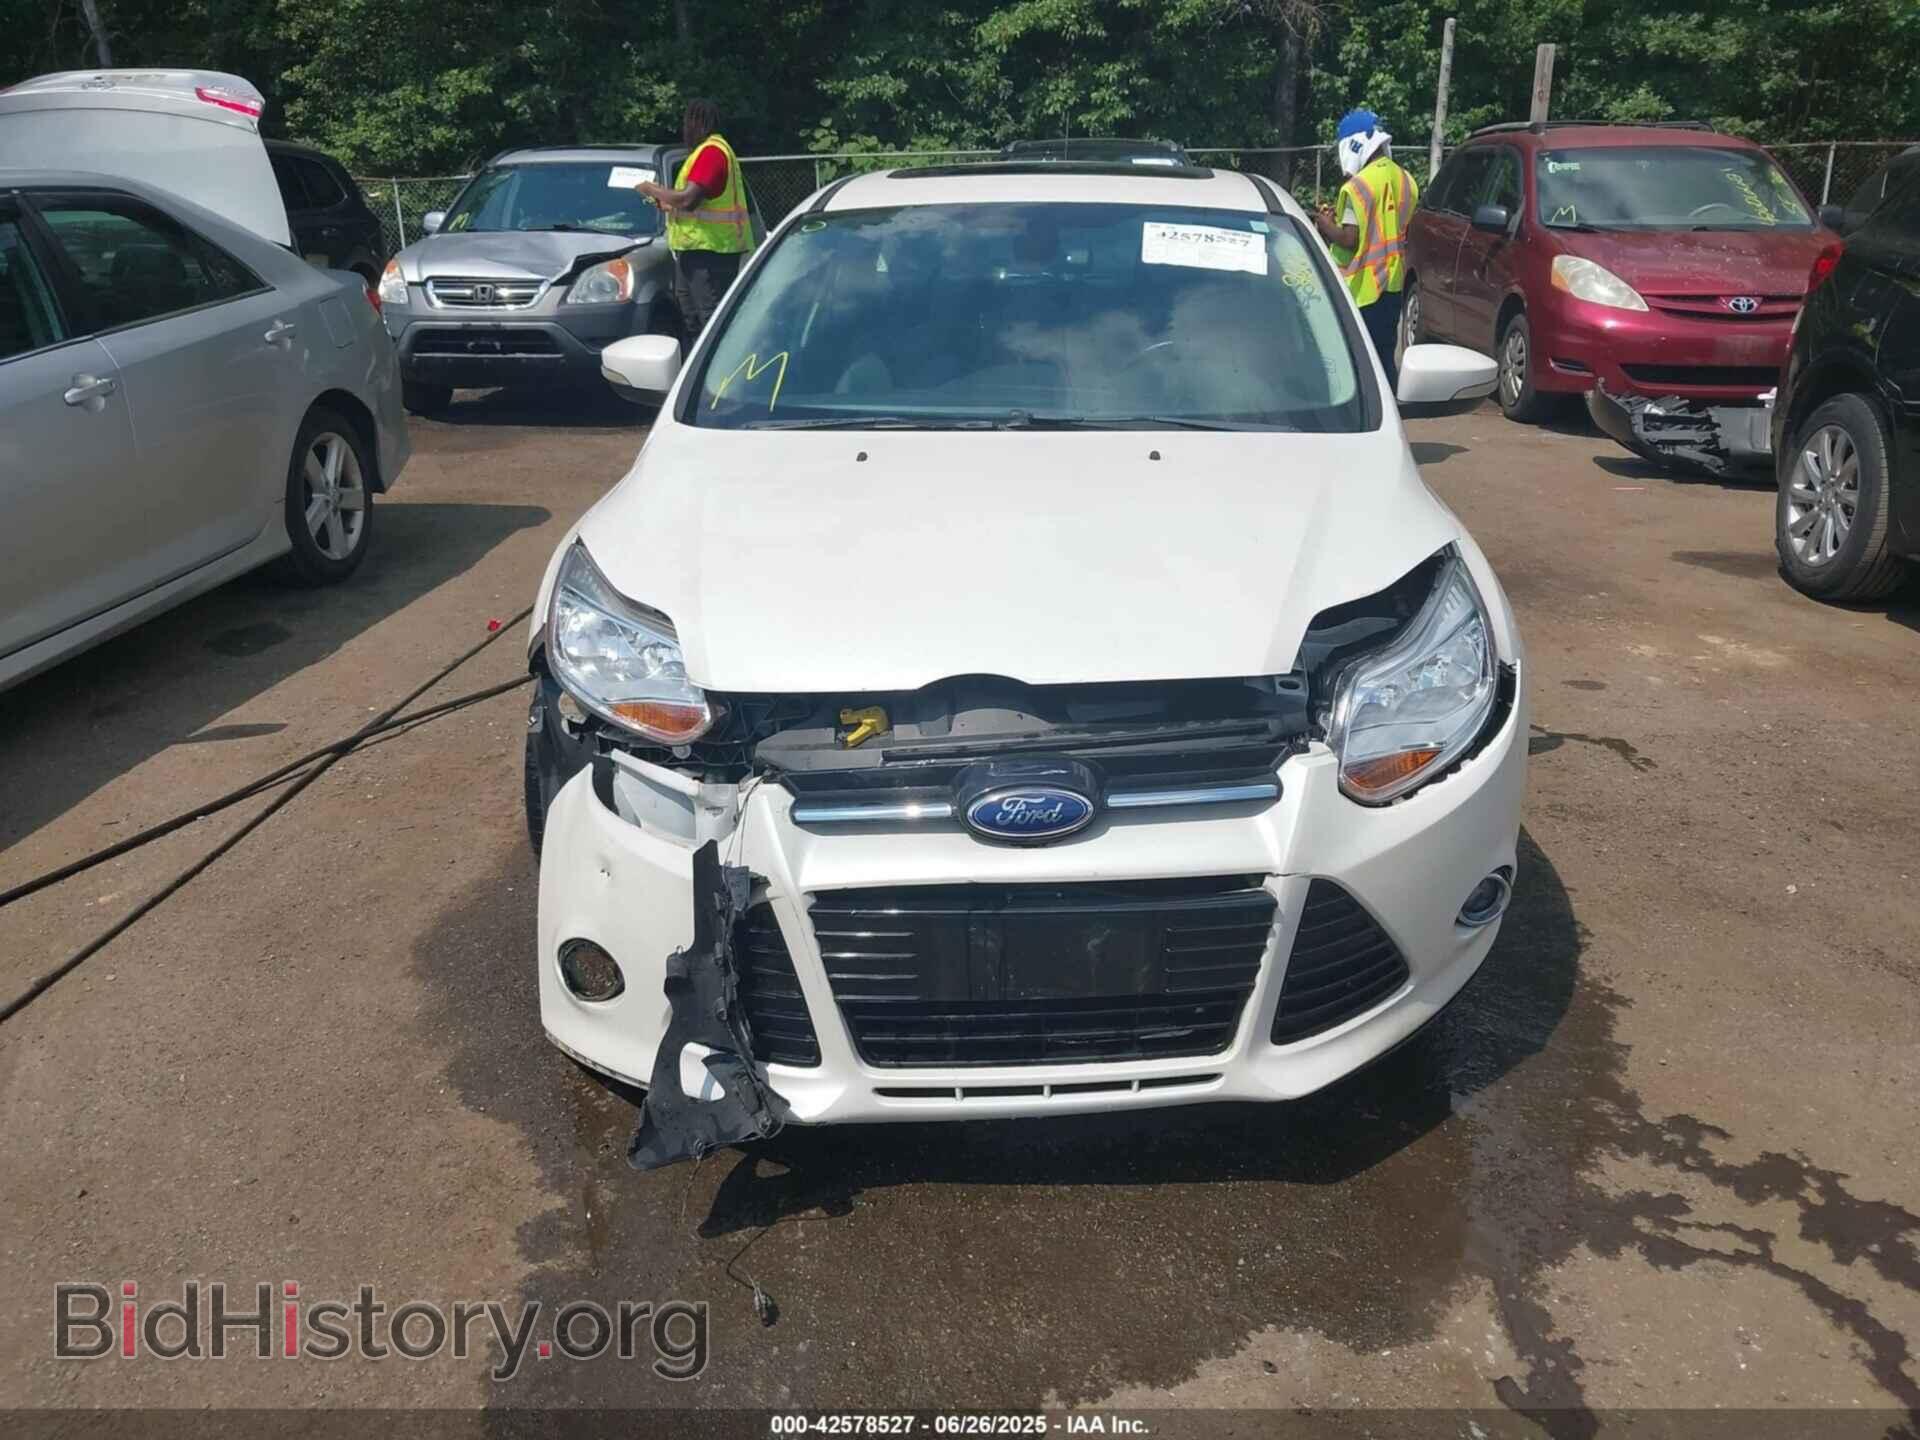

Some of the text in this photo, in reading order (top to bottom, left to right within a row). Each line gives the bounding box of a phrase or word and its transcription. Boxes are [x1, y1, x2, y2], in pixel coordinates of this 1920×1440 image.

[1551, 203, 1577, 224] M
[710, 351, 789, 413] M
[995, 797, 1064, 825] Ford
